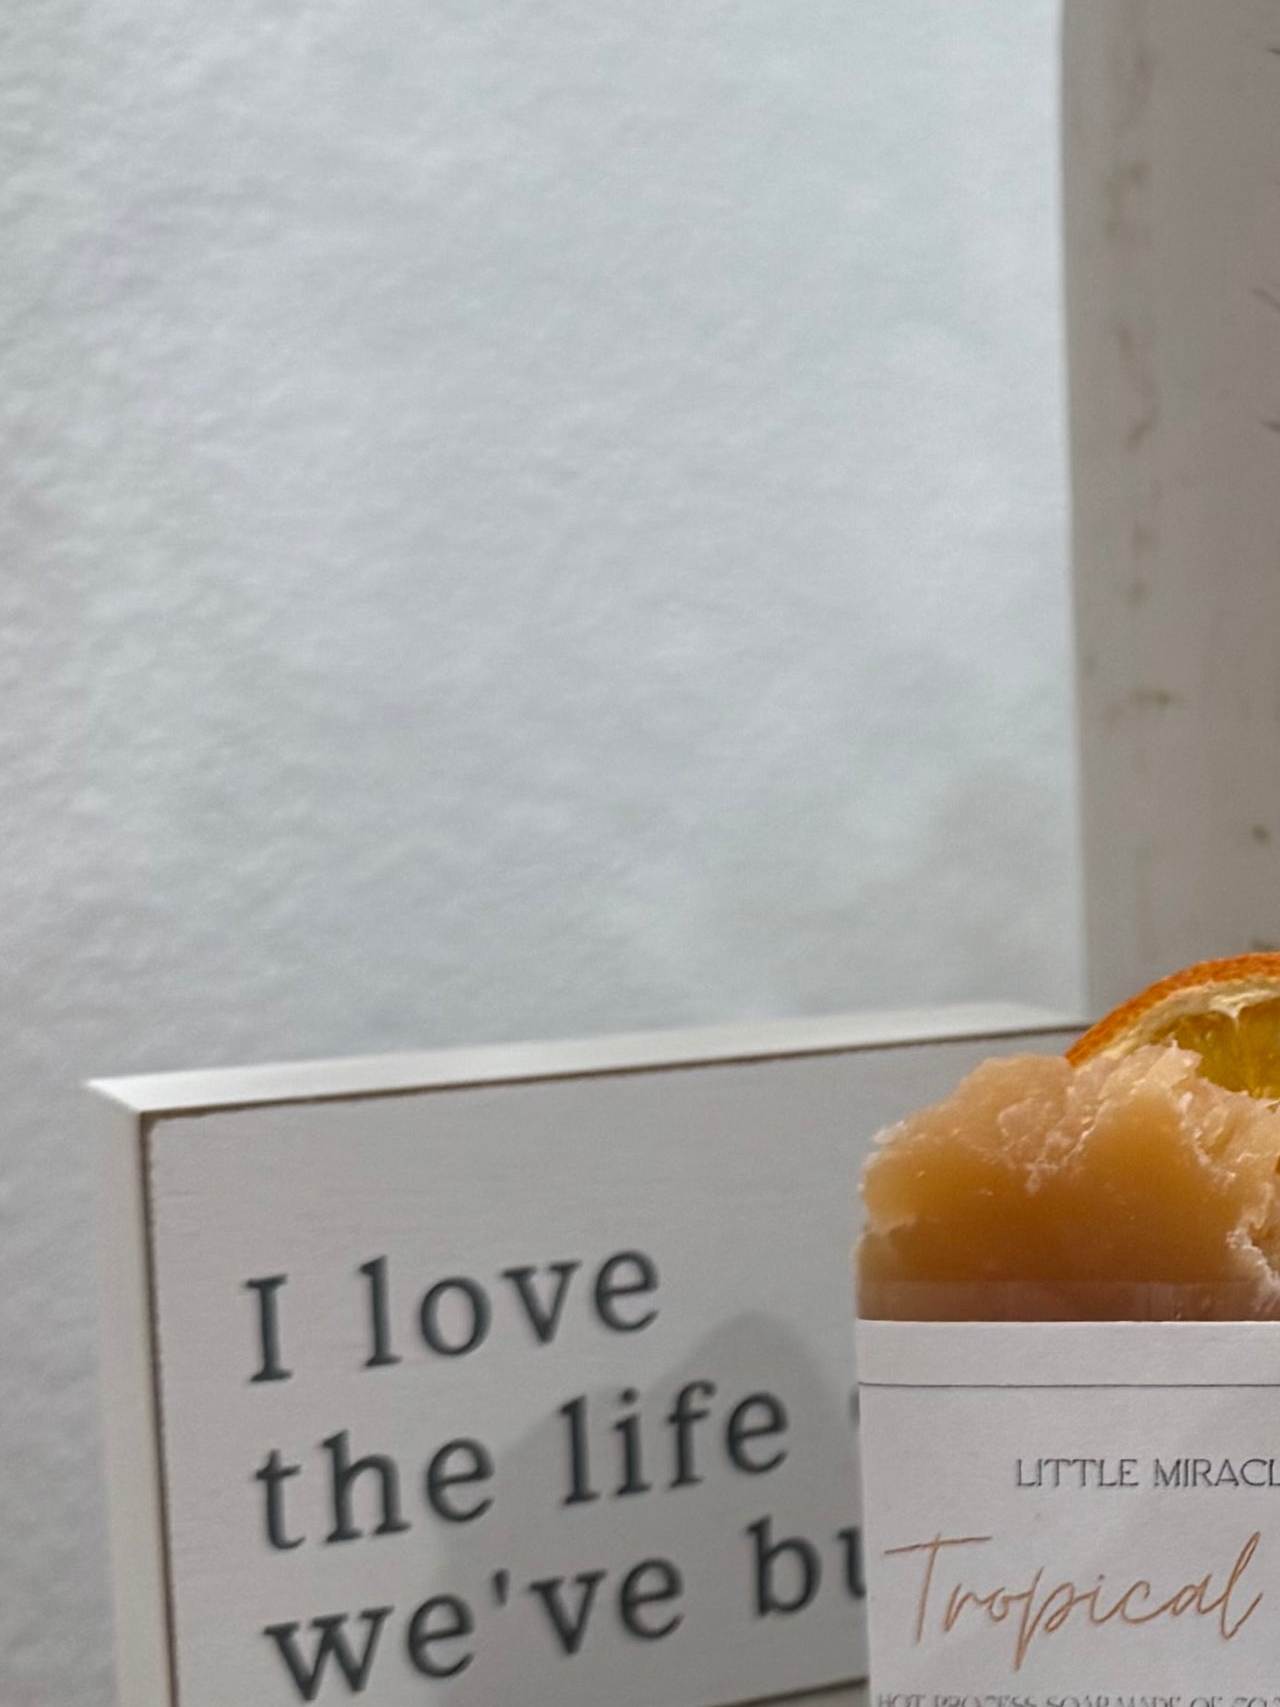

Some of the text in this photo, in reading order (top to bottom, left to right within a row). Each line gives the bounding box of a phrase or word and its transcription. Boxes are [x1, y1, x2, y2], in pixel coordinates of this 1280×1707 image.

[243, 1250, 658, 1384] I love
[252, 1380, 788, 1551] the life
[1015, 1457, 1140, 1489] LITTLE
[261, 1556, 682, 1703] we've
[884, 1531, 1263, 1672] Tropical
